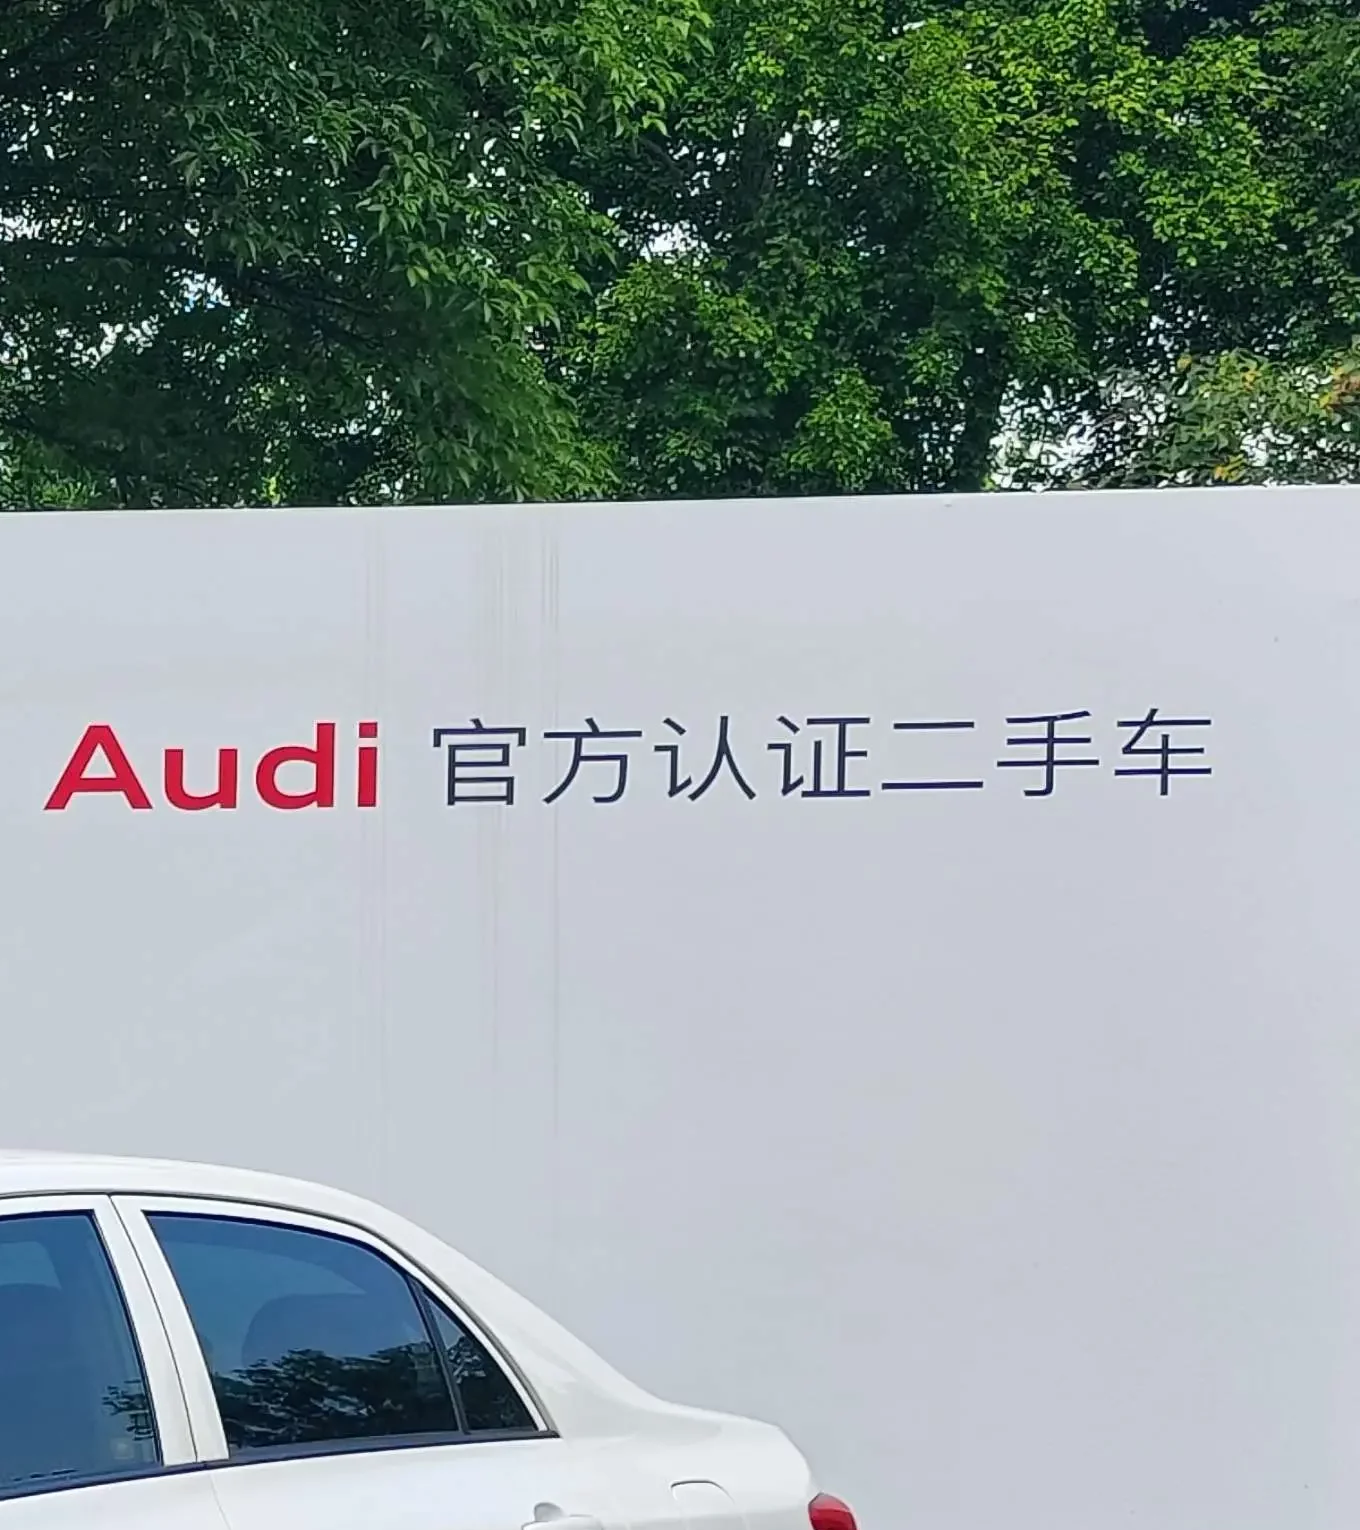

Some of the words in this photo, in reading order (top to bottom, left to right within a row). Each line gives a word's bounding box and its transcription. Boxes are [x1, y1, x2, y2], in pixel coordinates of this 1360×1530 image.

[45, 720, 379, 811] Audi
[432, 707, 1213, 807] 官方认证二手车
